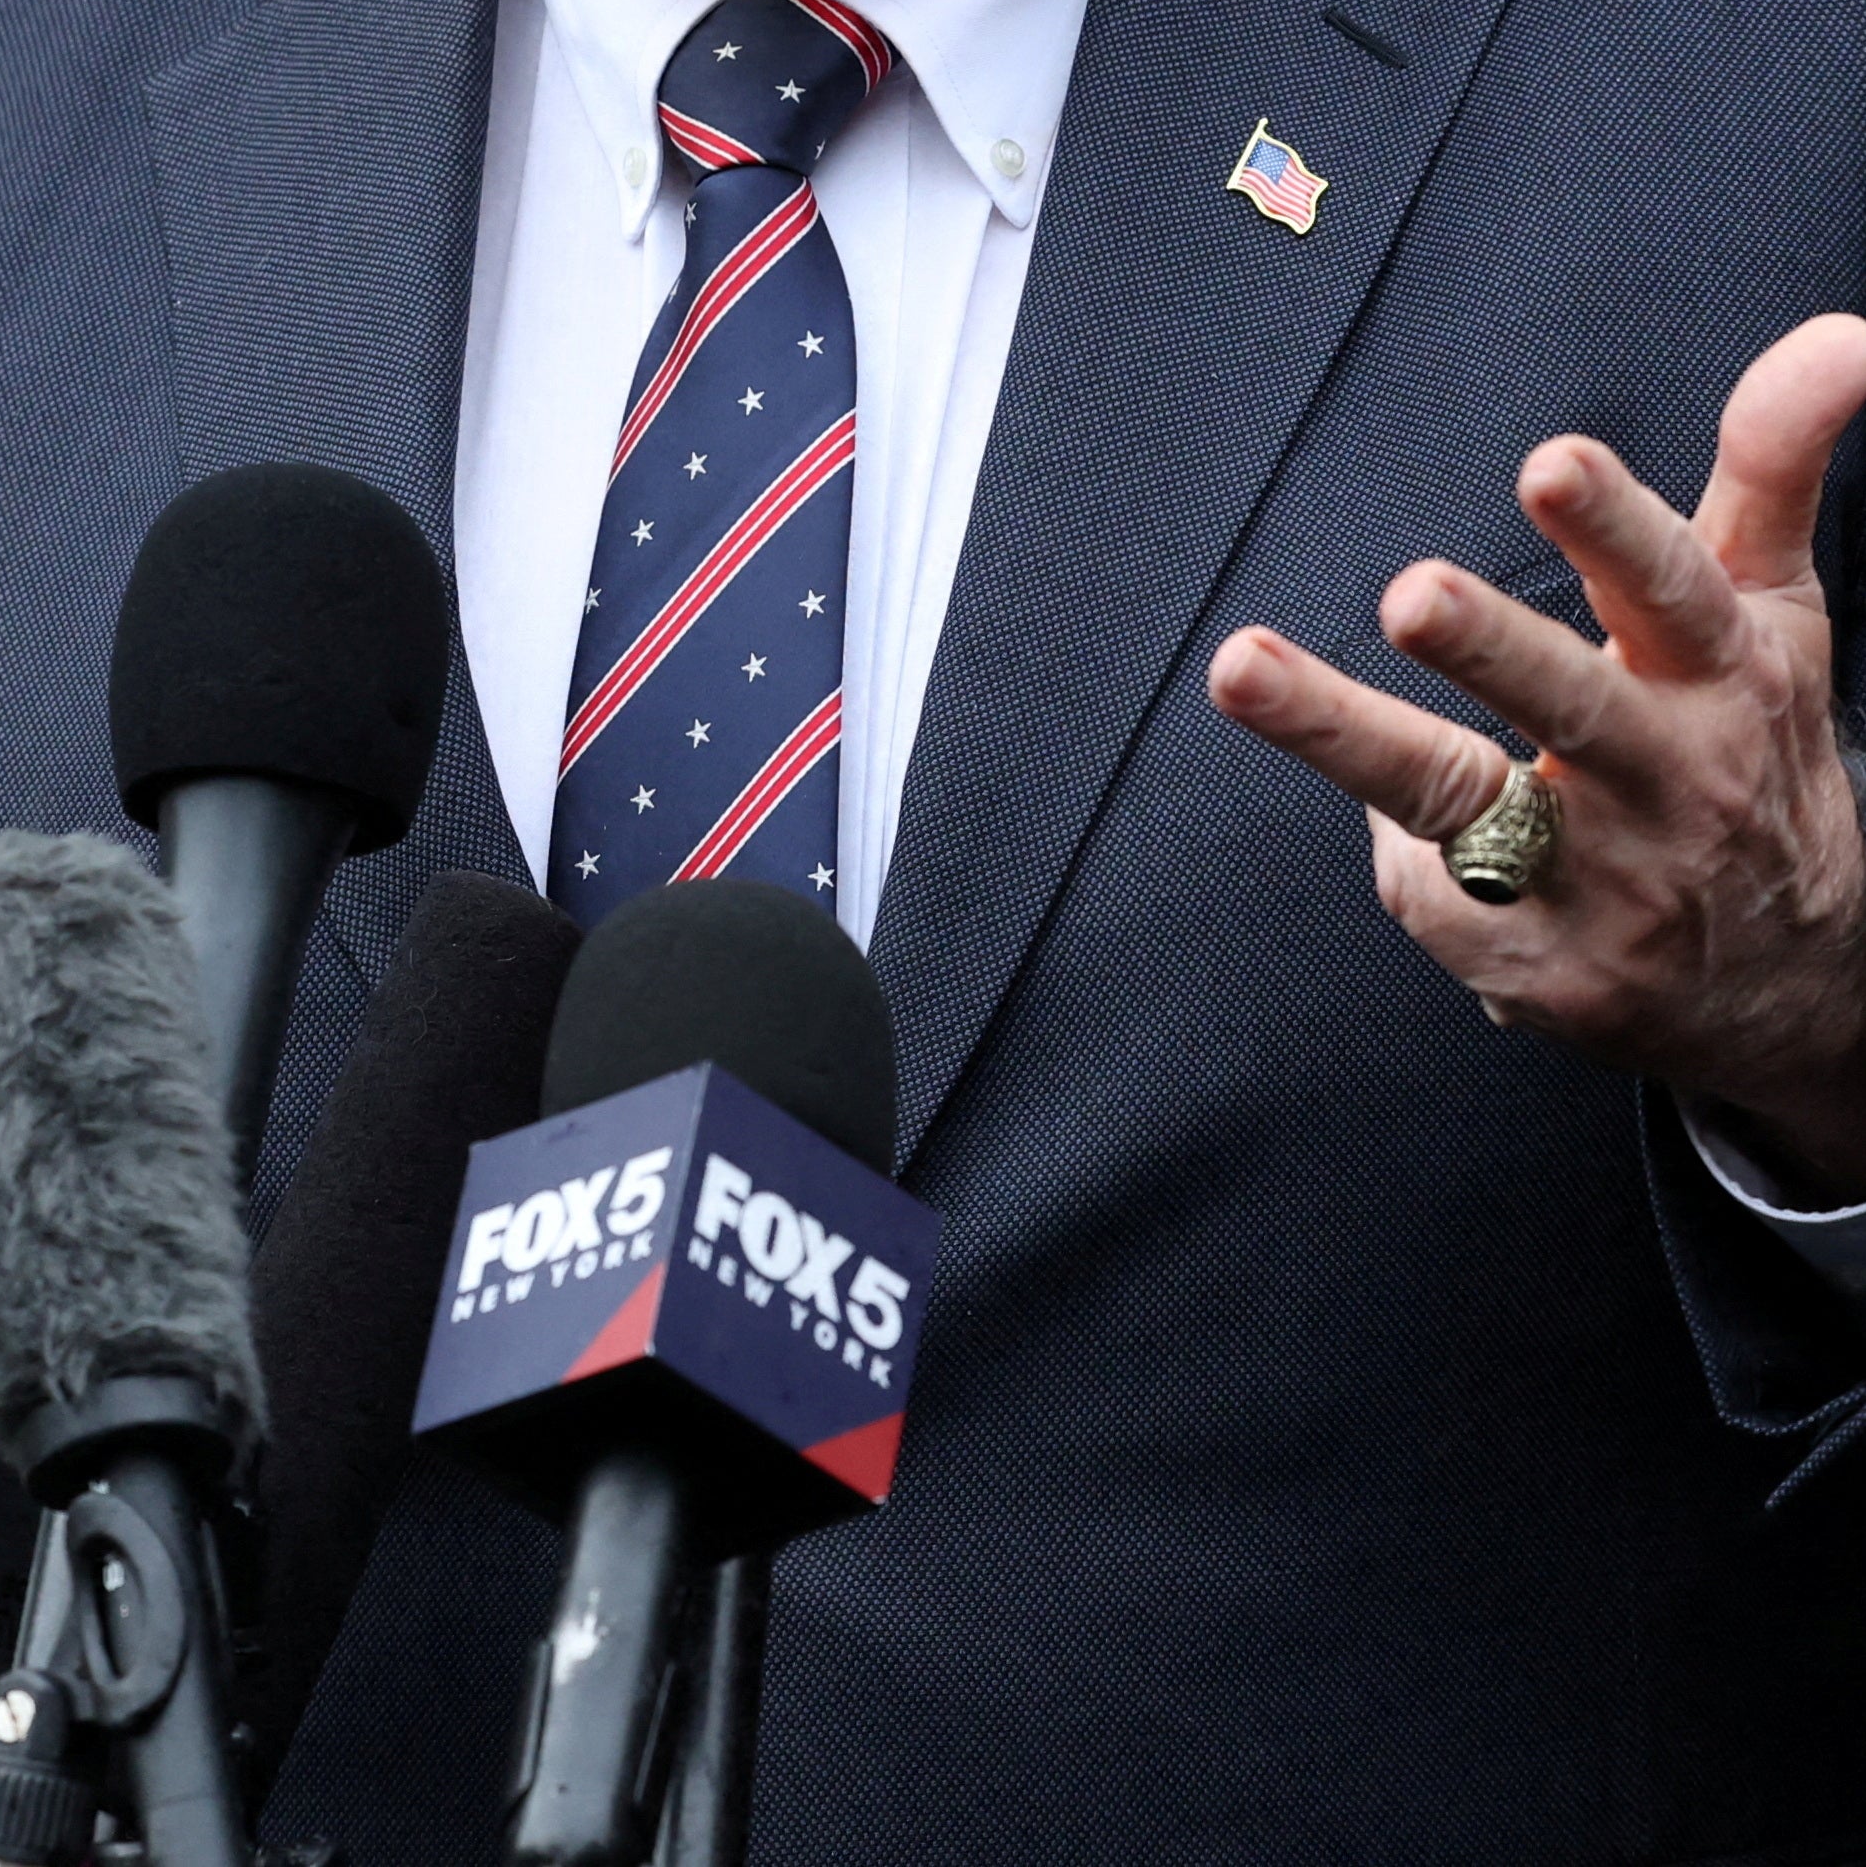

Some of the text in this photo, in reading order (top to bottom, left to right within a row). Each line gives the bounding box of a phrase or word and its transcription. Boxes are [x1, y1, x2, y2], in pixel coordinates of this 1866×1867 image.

[449, 1229, 656, 1324] NEW YORK
[687, 1236, 894, 1391] NEW YORK
